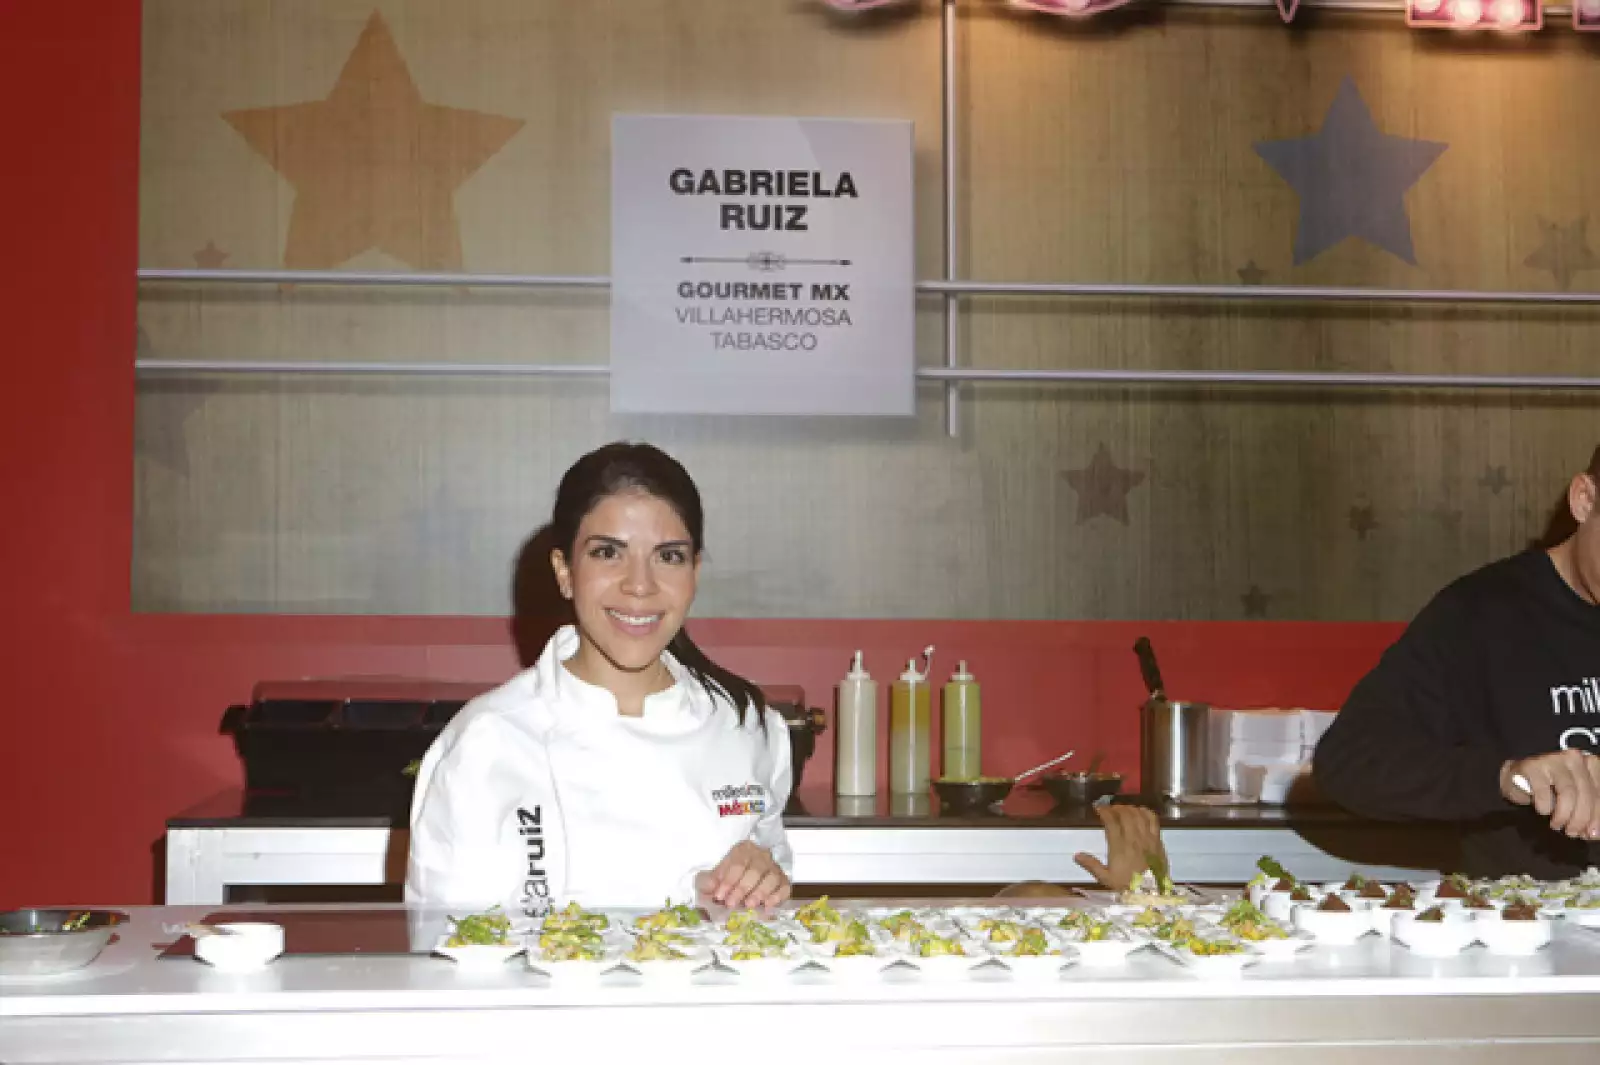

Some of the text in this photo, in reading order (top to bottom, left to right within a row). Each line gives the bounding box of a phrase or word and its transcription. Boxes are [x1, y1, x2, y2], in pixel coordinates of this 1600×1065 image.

[670, 168, 858, 198] GABRIELA
[720, 204, 808, 230] RUIZ
[677, 282, 850, 300] GOURMET MX
[675, 307, 852, 325] VILLAHERMOSA
[710, 332, 817, 350] TABASCO
[1550, 676, 1600, 714] mil
